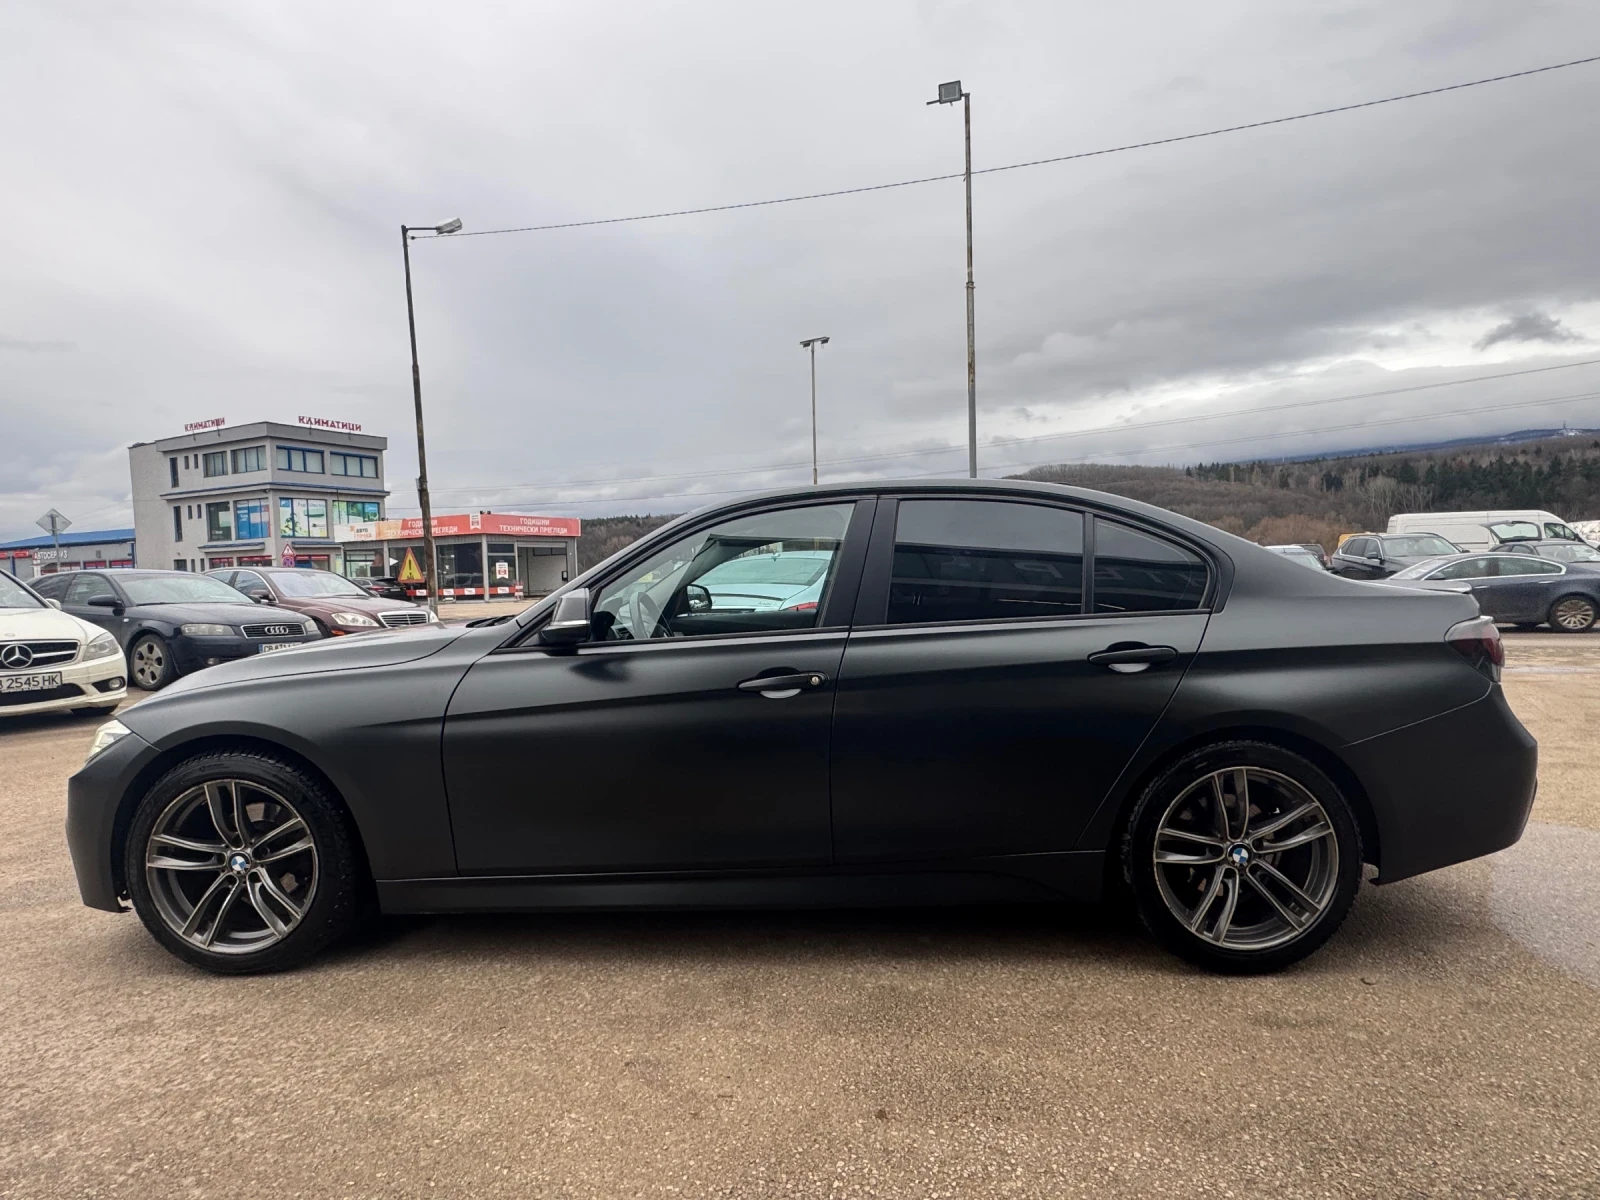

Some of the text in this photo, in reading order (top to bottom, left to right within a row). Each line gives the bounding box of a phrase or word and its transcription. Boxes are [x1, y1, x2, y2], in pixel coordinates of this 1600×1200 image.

[184, 417, 225, 432] КЛИМАТИЦИ
[298, 416, 362, 432] КЛИМАТИЦИ
[519, 517, 550, 526] ГОДИШНИ
[432, 526, 458, 534] РЕГЛЕДИ
[499, 524, 568, 535] ТЕХНИЧЕСКИ ПРЕГЛЕДИ
[6, 676, 40, 689] 2545
